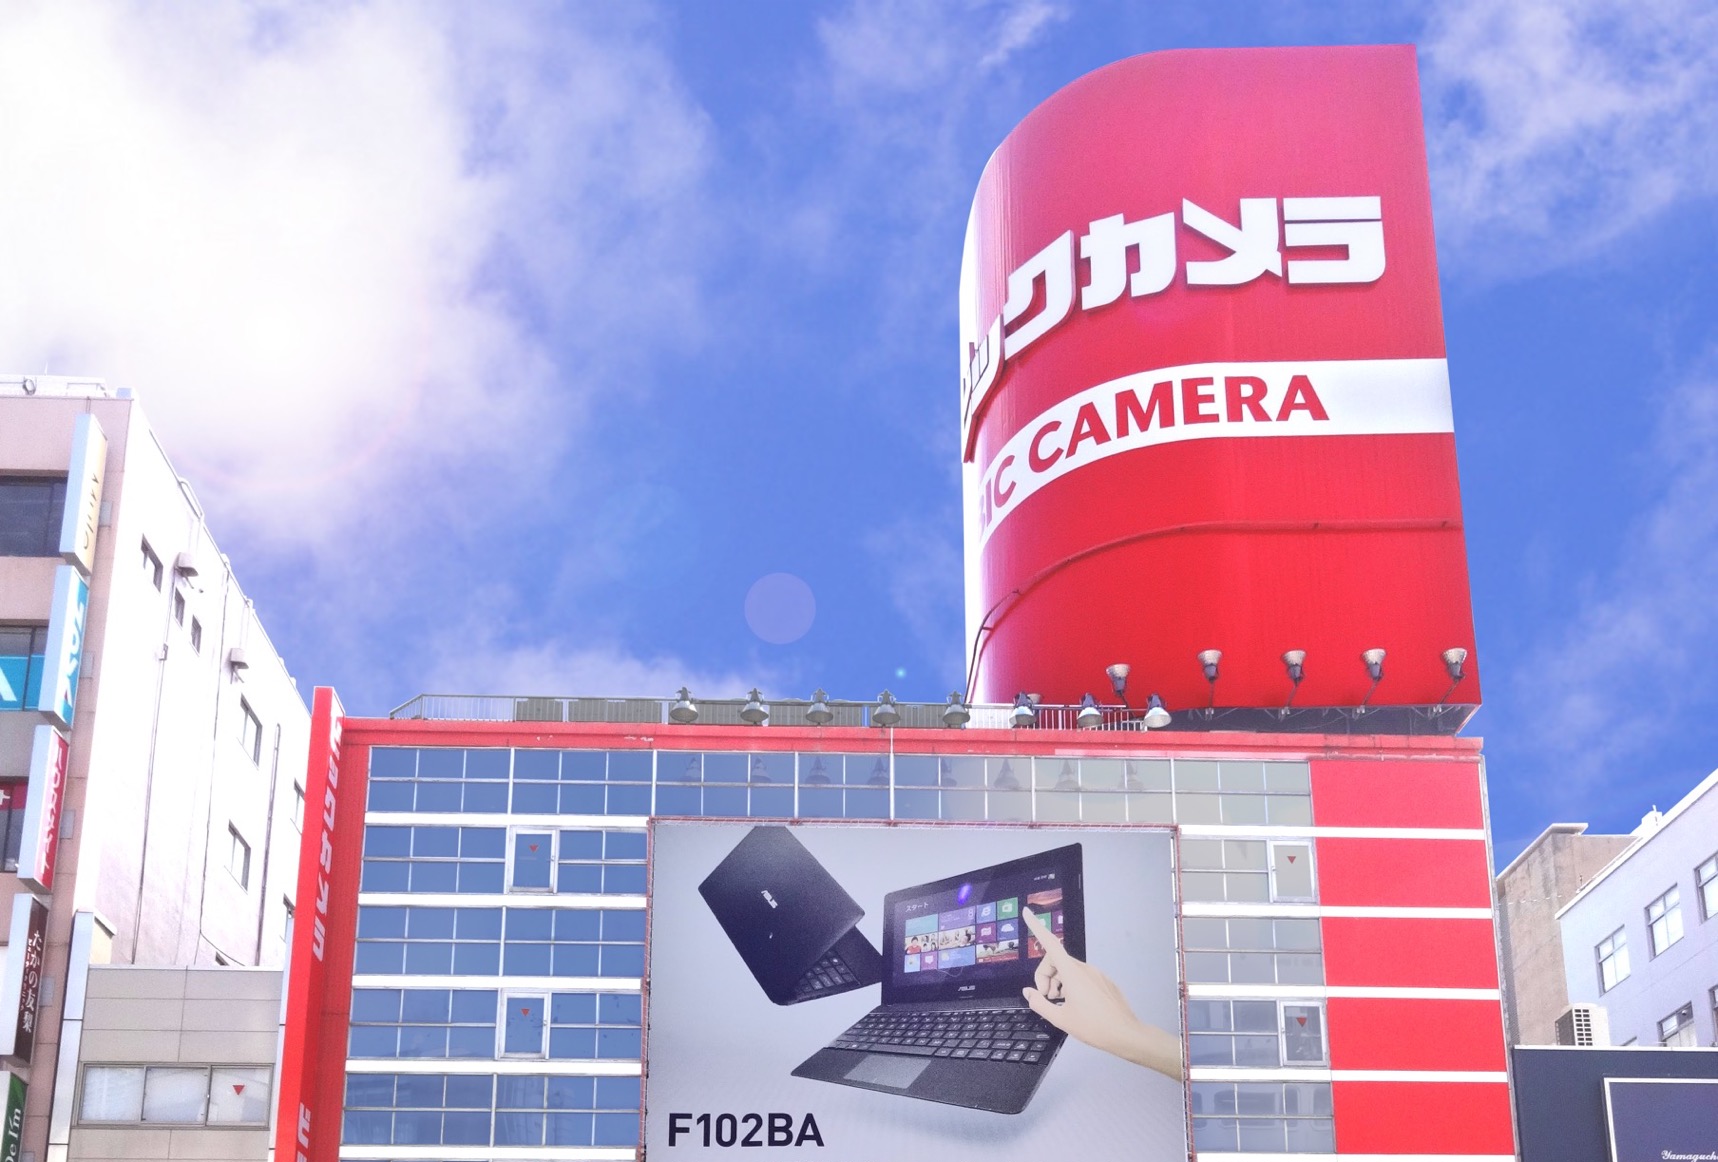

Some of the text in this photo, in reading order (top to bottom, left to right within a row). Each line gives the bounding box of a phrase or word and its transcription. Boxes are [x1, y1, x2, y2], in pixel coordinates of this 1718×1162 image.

[963, 196, 1386, 463] ックカメラ
[1028, 374, 1330, 474] CAMERA
[668, 1112, 825, 1148] F102BA
